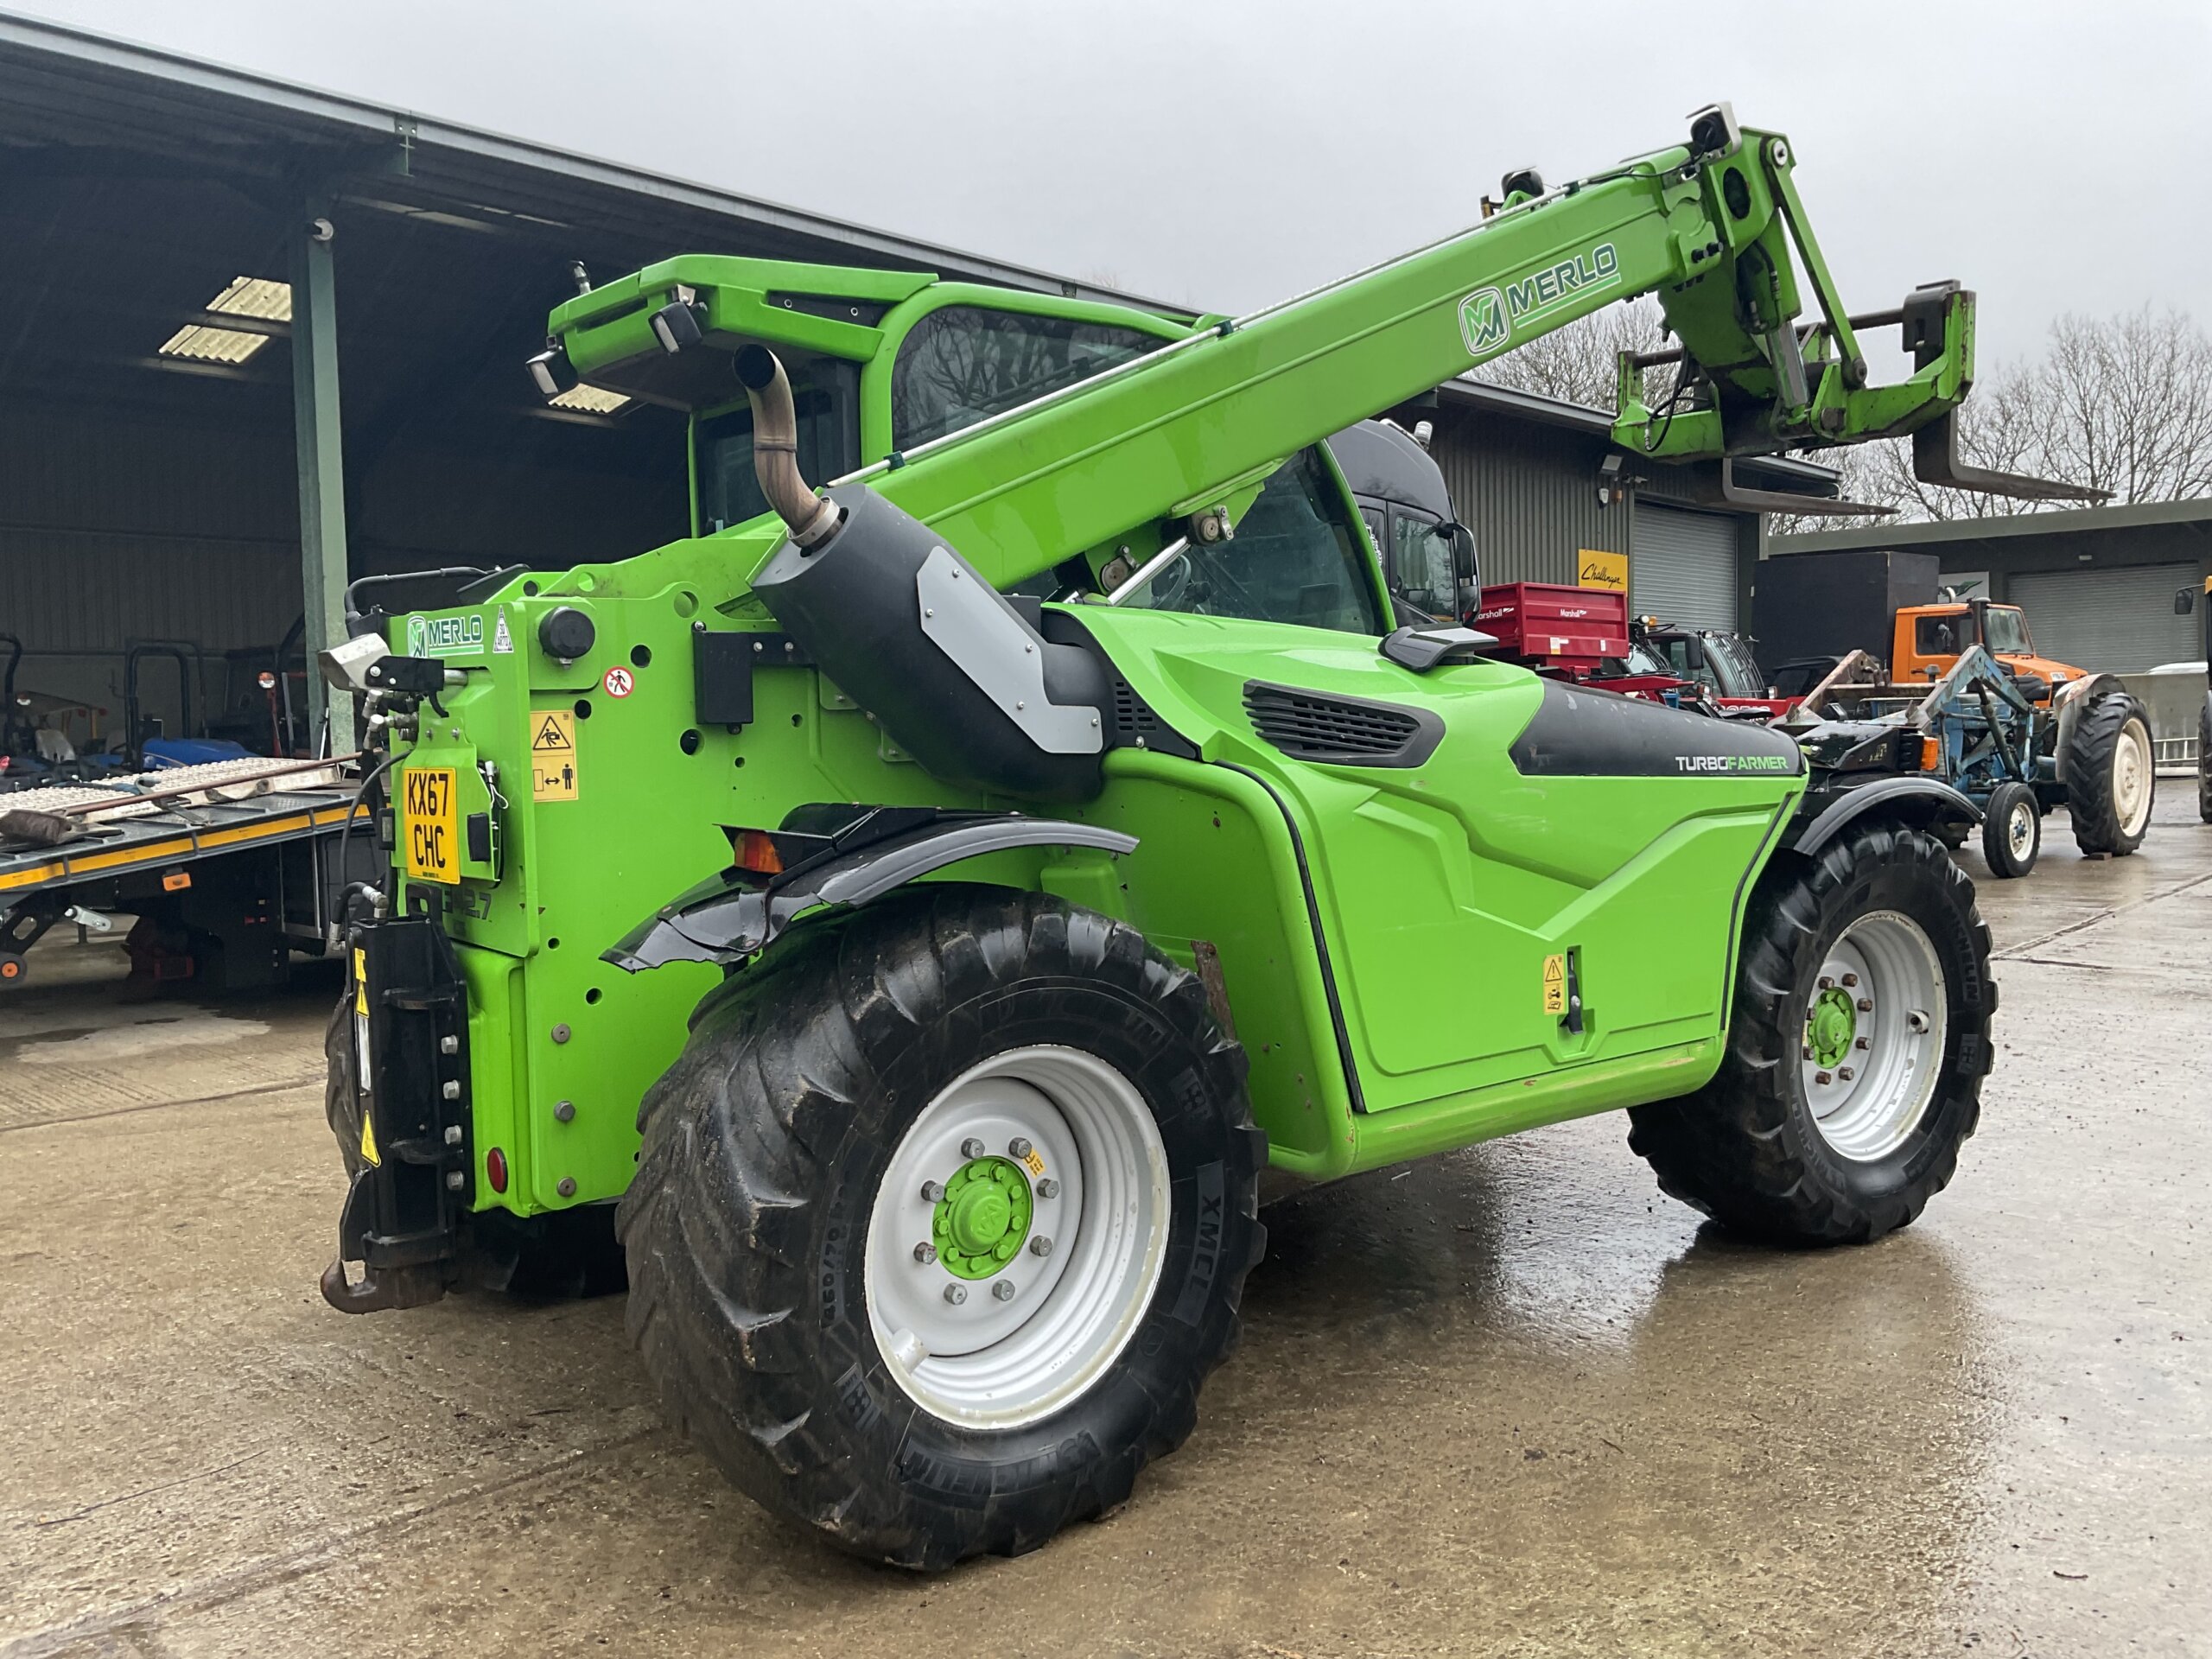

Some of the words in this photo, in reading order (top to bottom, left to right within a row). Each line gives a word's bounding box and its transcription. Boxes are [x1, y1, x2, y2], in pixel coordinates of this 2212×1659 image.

[1508, 243, 1618, 315] MERLO
[1580, 563, 1624, 588] Challenger
[1478, 607, 1503, 620] arshall
[1560, 608, 1580, 618] Marshall
[429, 615, 483, 646] MERLO
[1675, 755, 1789, 771] TURBOFARMER
[408, 772, 448, 817] KX67
[414, 823, 446, 868] CHC
[1190, 1195, 1222, 1290] XMCL
